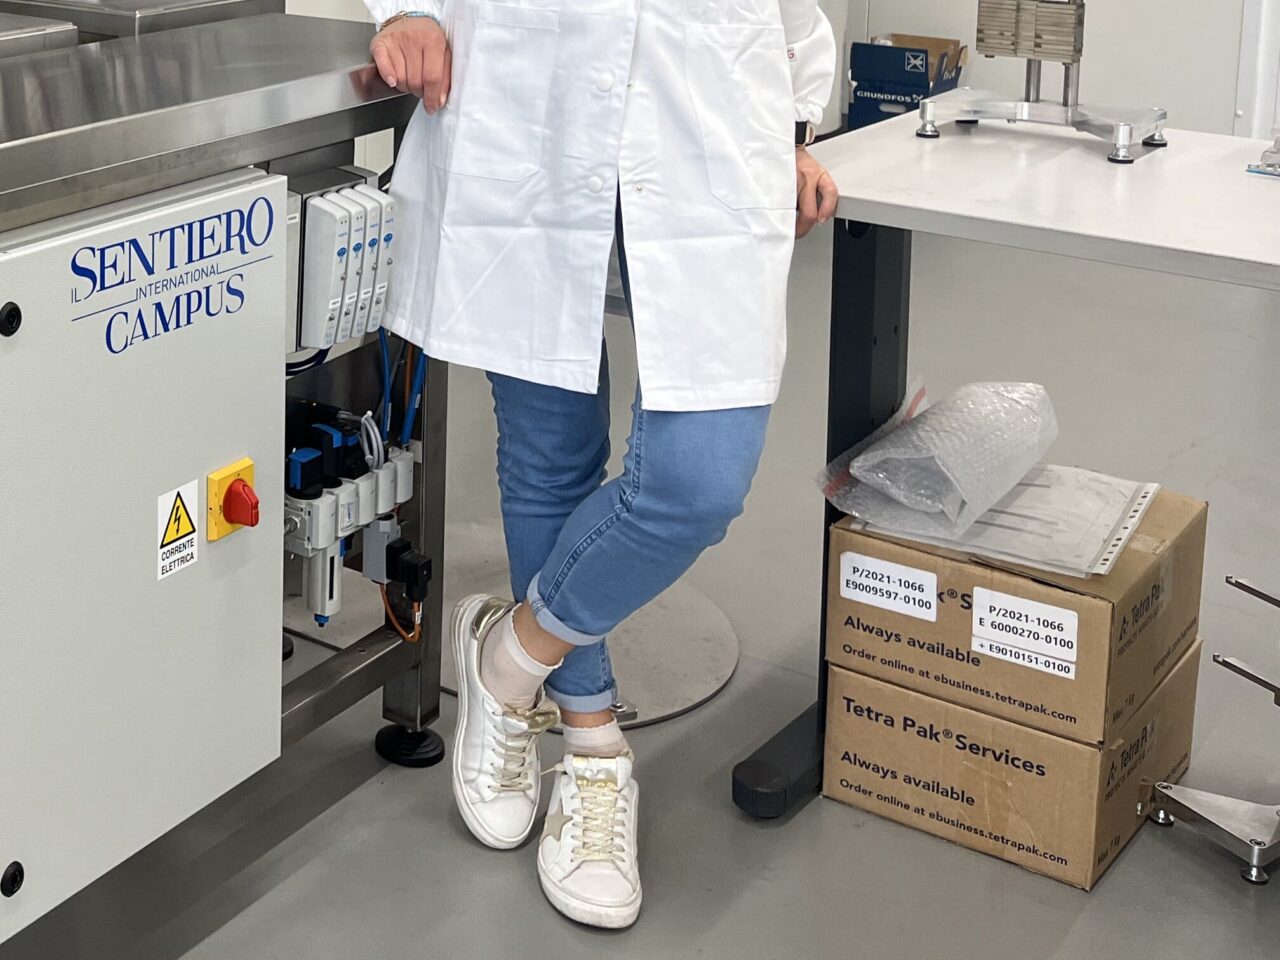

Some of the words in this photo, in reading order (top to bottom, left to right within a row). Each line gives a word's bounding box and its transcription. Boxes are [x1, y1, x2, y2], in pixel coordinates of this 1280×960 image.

[857, 90, 911, 103] GRUNDFOS
[70, 196, 274, 300] SENTIERO
[71, 287, 82, 304] IL
[136, 263, 221, 300] INTERNATIONAL
[105, 273, 245, 354] CAMPUS
[161, 538, 195, 561] CORRENTE
[161, 552, 195, 575] ELETTRICA
[845, 579, 932, 610] E9009597-0100
[852, 566, 925, 593] P/2021-1066
[978, 617, 985, 627] E
[990, 621, 1074, 650] 6000270-0100
[989, 605, 1064, 632] P/2021-1066
[843, 615, 902, 643] Always
[907, 637, 981, 667] available
[989, 643, 1071, 674] E9010151-0100
[842, 644, 877, 661] Order
[880, 657, 915, 674] online
[918, 669, 931, 679] at
[933, 674, 1077, 724] ebusiness.tetrapak.com
[842, 696, 895, 728] Tetra
[955, 733, 1046, 777] Services
[841, 750, 898, 779] Always
[903, 774, 975, 806] available
[839, 778, 873, 797] Order
[876, 793, 910, 810] online
[913, 807, 925, 816] at
[928, 811, 1068, 866] ebusiness.tetrapak.com
